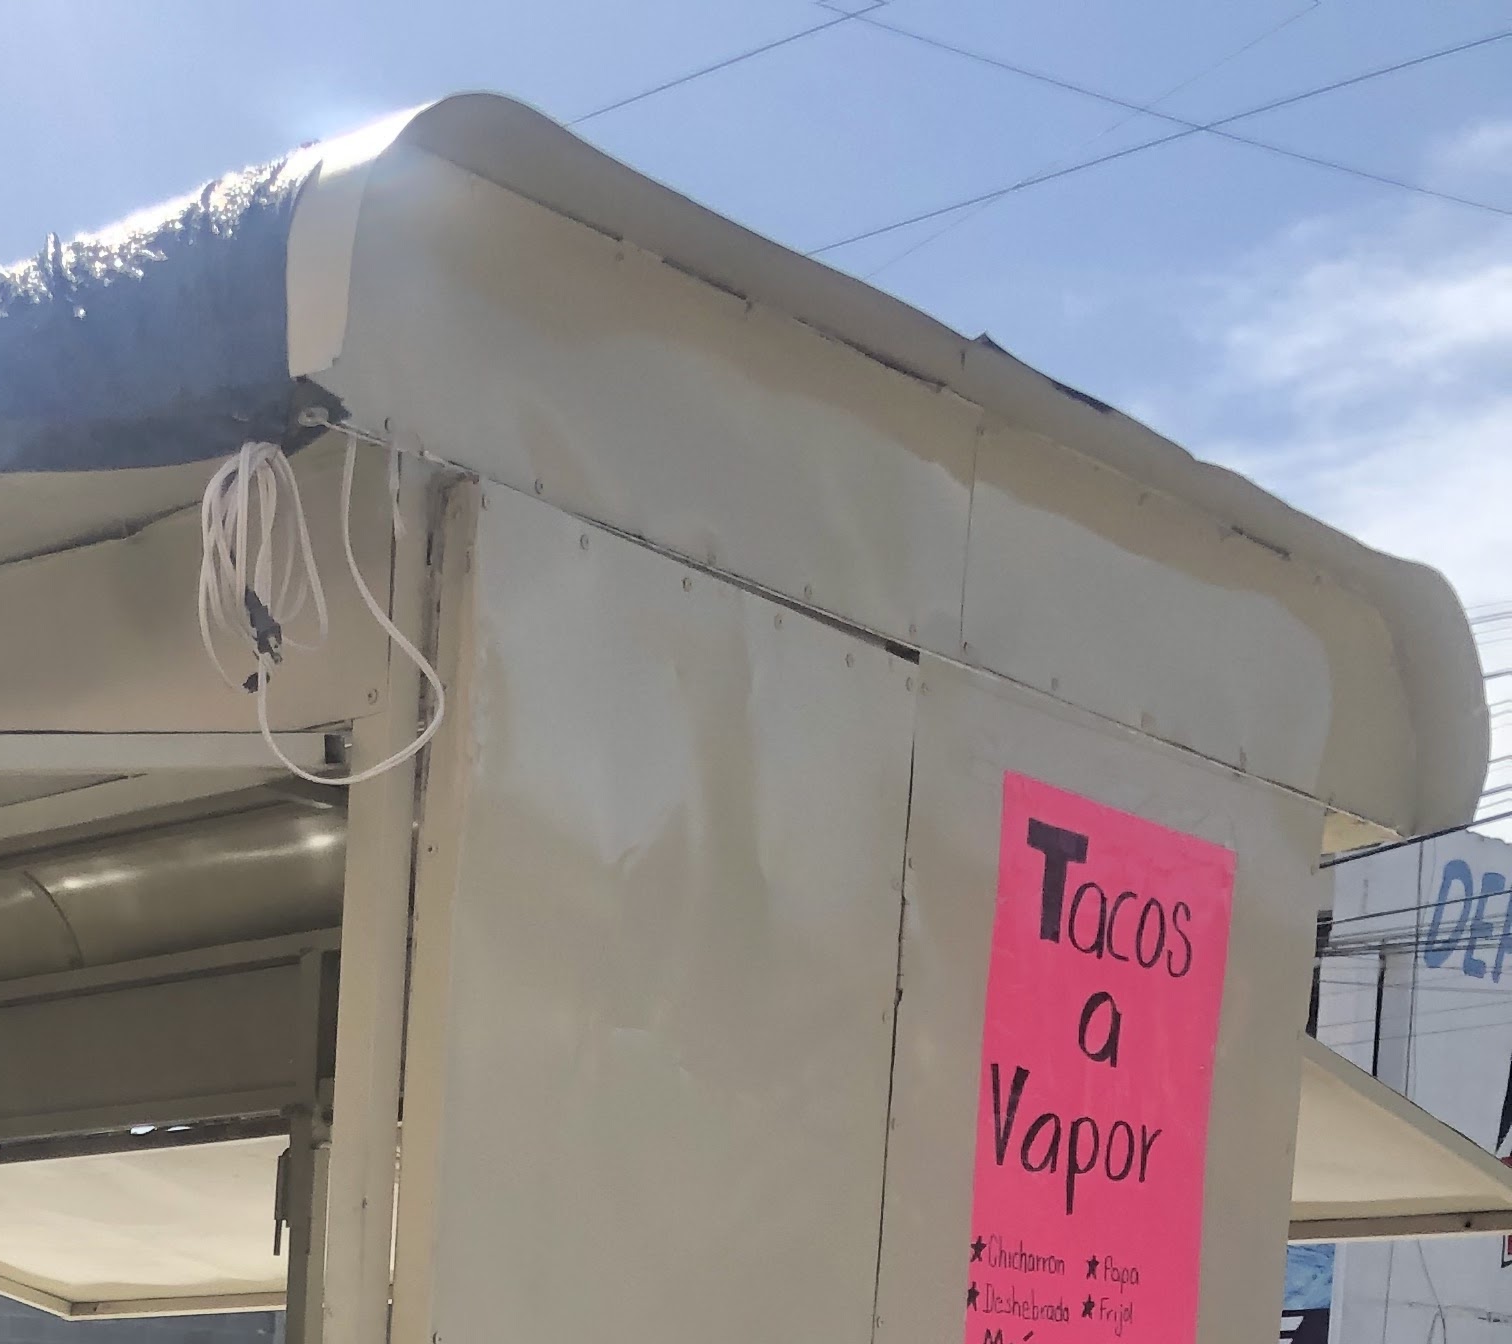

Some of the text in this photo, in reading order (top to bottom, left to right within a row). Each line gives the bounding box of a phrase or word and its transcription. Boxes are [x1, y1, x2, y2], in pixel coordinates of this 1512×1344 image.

[1027, 817, 1193, 978] Tacos
[1078, 990, 1122, 1068] a
[990, 1062, 1163, 1216] Vapor
[987, 1234, 1065, 1275] Chicharron
[1104, 1255, 1140, 1293] Papa
[983, 1283, 1070, 1323] Deshebrada
[1100, 1297, 1133, 1337] Frijol
